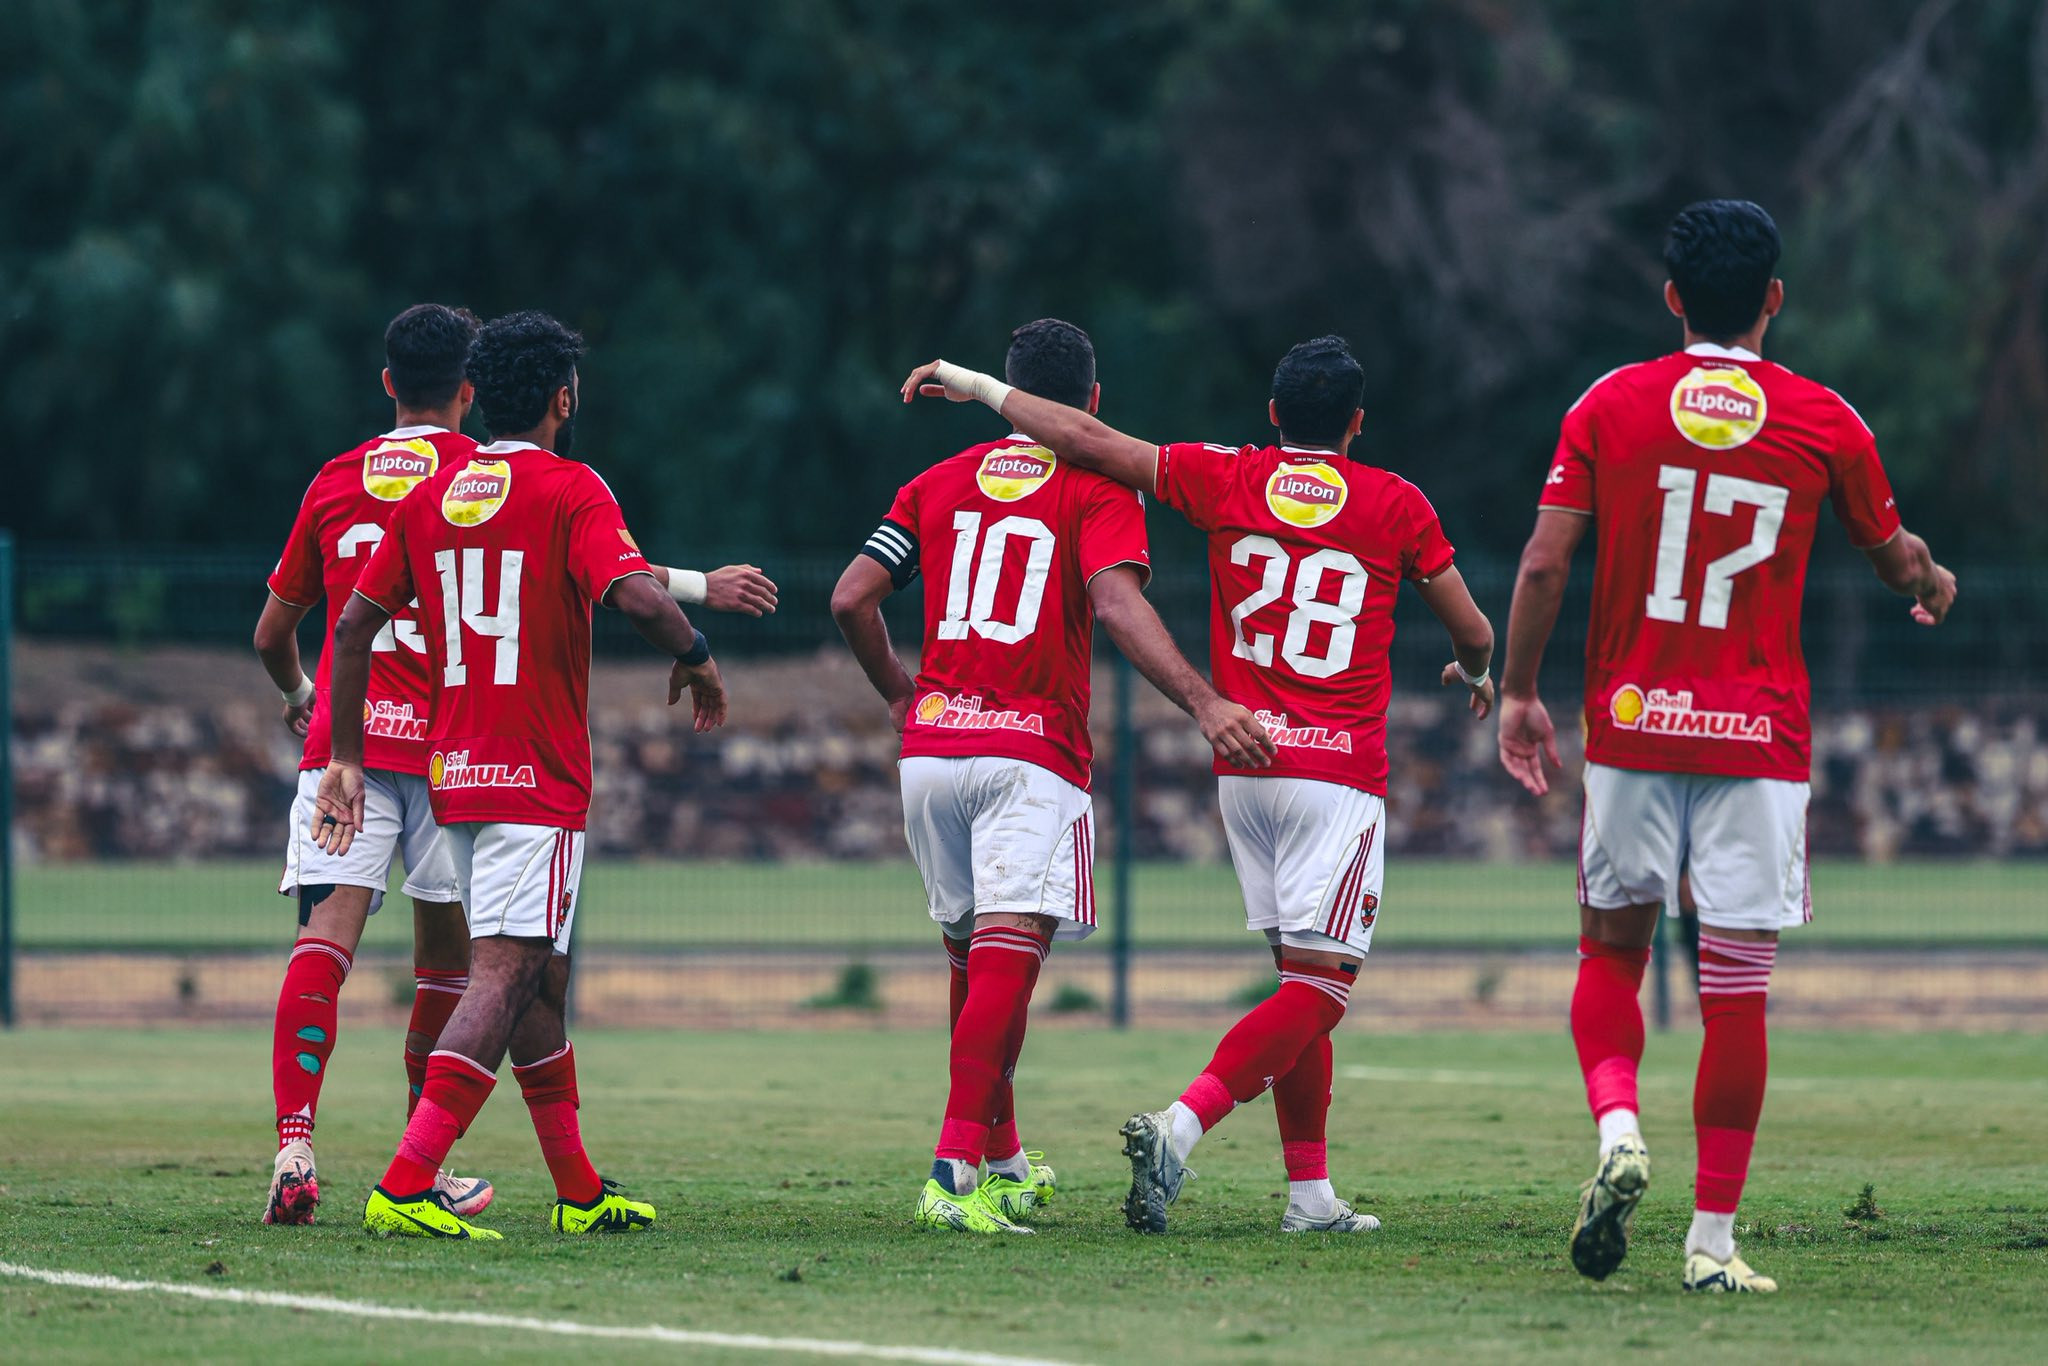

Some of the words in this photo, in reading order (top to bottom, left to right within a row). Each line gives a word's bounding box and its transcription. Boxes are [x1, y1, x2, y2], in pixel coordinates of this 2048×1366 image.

[1684, 389, 1753, 417] Lipton
[372, 455, 426, 473] Lipton
[987, 458, 1043, 475] Lipton
[452, 480, 499, 498] Lipton
[1277, 477, 1335, 500] Lipton
[1645, 463, 1790, 630] 17
[937, 510, 1056, 645] 10
[434, 548, 525, 688] 14
[1230, 534, 1369, 679] 28
[376, 701, 412, 718] Shell
[1650, 692, 1690, 709] Shell
[369, 716, 427, 740] RIM
[939, 708, 1043, 735] RIMULA
[1255, 710, 1287, 727] Shell
[1644, 710, 1770, 739] RIMULA
[443, 764, 536, 789] RIMULA
